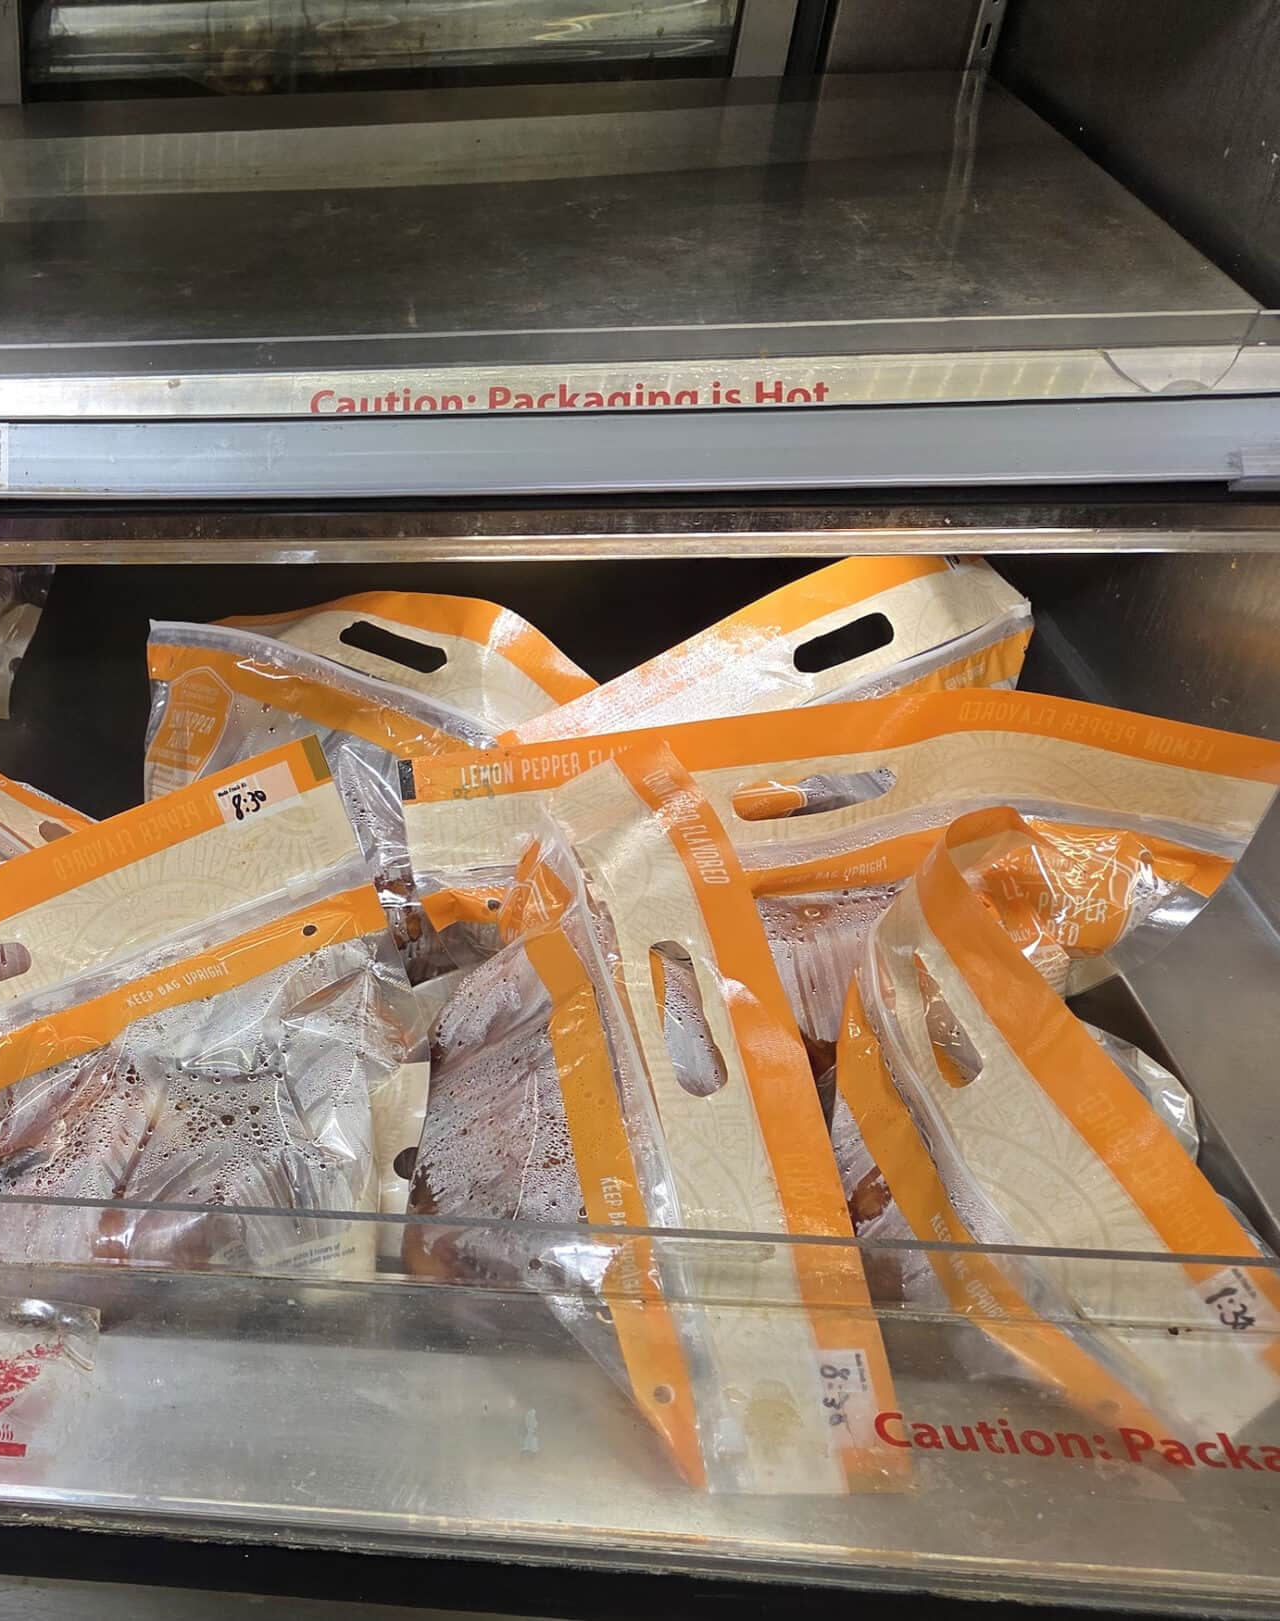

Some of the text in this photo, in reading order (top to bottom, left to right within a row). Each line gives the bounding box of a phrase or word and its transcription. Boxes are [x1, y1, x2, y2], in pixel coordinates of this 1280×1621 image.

[460, 759, 514, 788] LEMON
[522, 752, 582, 782] PEPPER
[232, 790, 267, 820] 8:30
[679, 824, 730, 884] FLAVORED
[843, 856, 888, 880] UPRIGHT
[125, 962, 229, 1008] KEEP BAG UPRIGHT
[600, 1177, 624, 1207] KEEP
[874, 1411, 1113, 1460] Caution:
